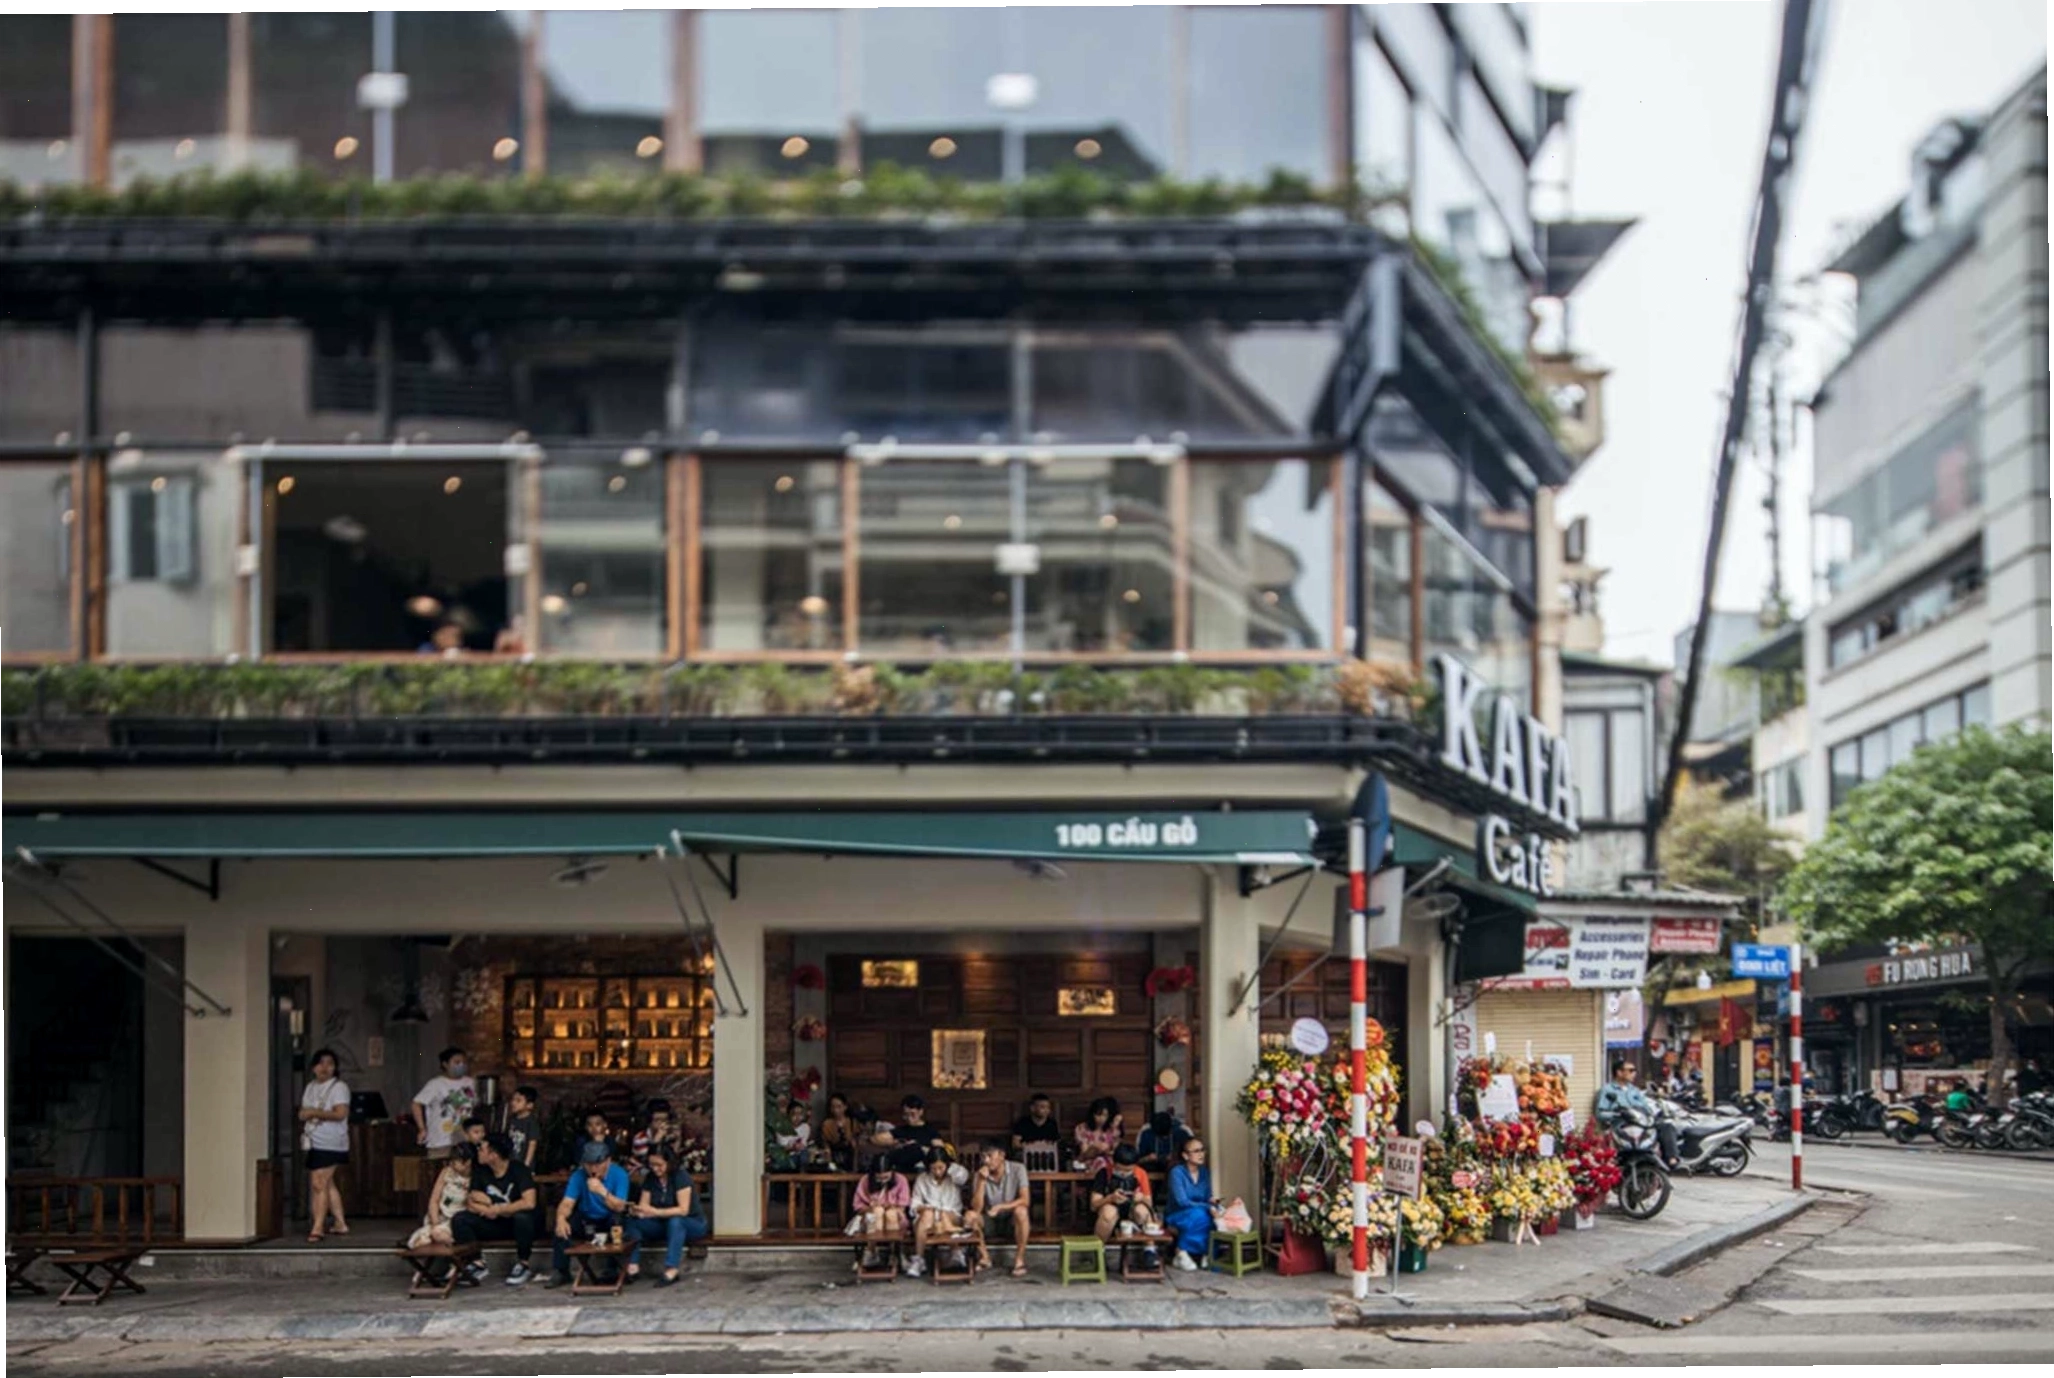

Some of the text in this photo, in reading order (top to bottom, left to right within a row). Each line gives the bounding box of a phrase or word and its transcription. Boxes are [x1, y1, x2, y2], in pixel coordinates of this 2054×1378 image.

[1440, 653, 1580, 834] KAFA
[1055, 823, 1102, 847] 100
[1579, 929, 1645, 943] Accessories
[1575, 949, 1645, 963] Repair Phone
[1579, 968, 1601, 980] Sim
[1611, 968, 1636, 980] Card
[1883, 961, 1900, 984] FU
[1903, 956, 1938, 981] RONG
[1940, 951, 1971, 977] HUA
